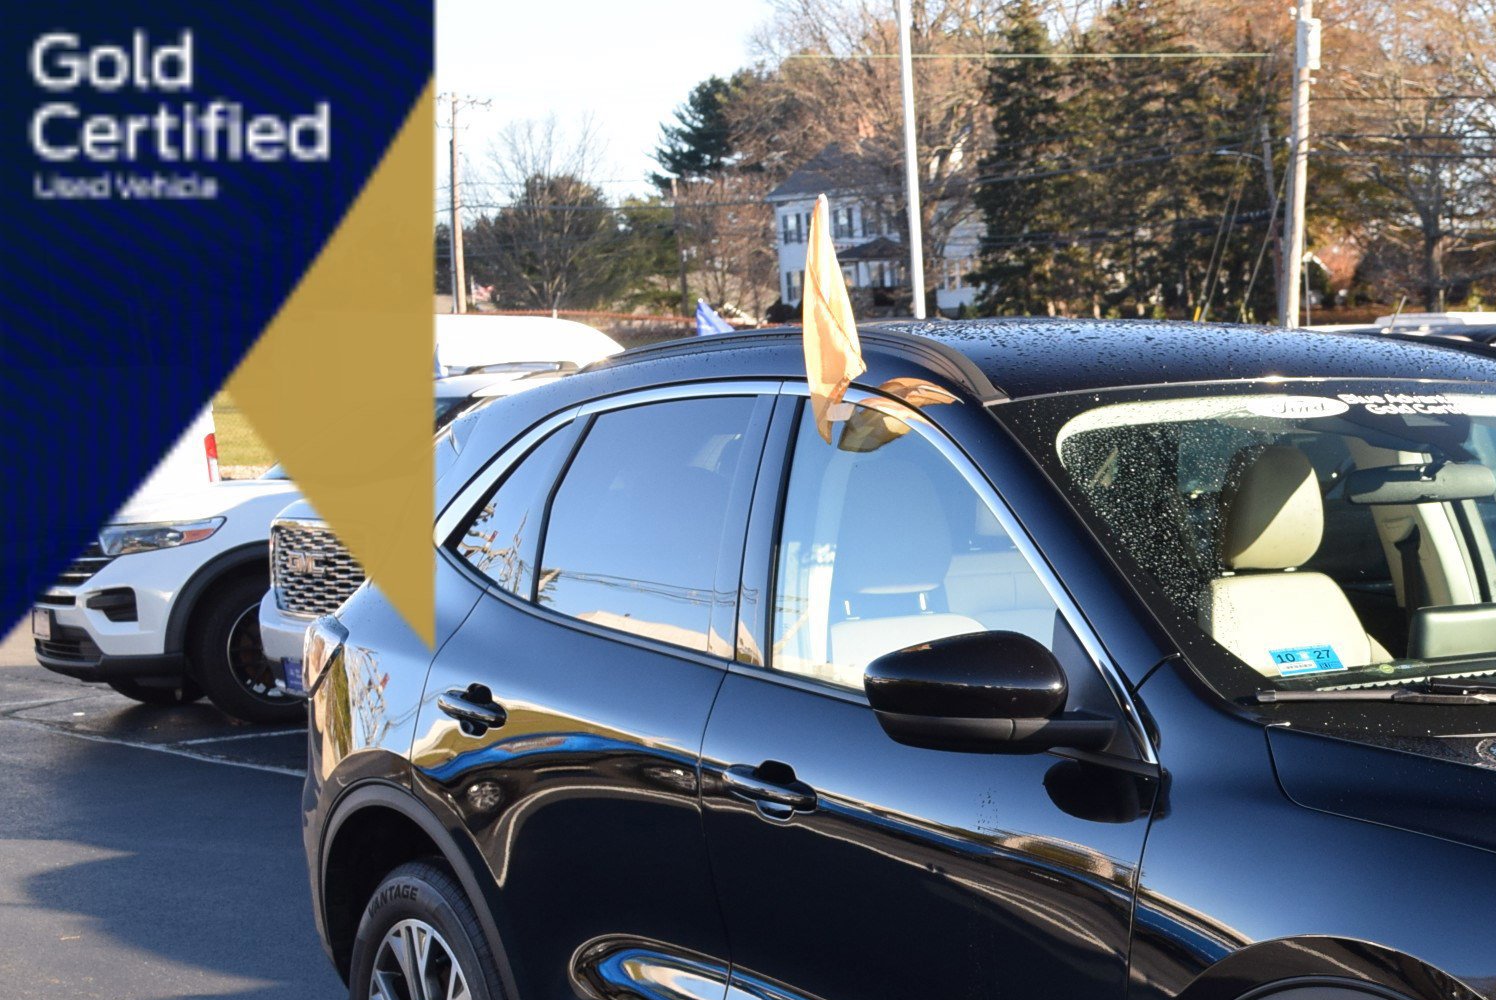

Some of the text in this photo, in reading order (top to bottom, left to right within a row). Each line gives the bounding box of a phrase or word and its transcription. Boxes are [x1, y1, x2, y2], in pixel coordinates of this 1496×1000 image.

[1277, 649, 1330, 664] 10 27
[368, 884, 419, 918] VANTAGE
